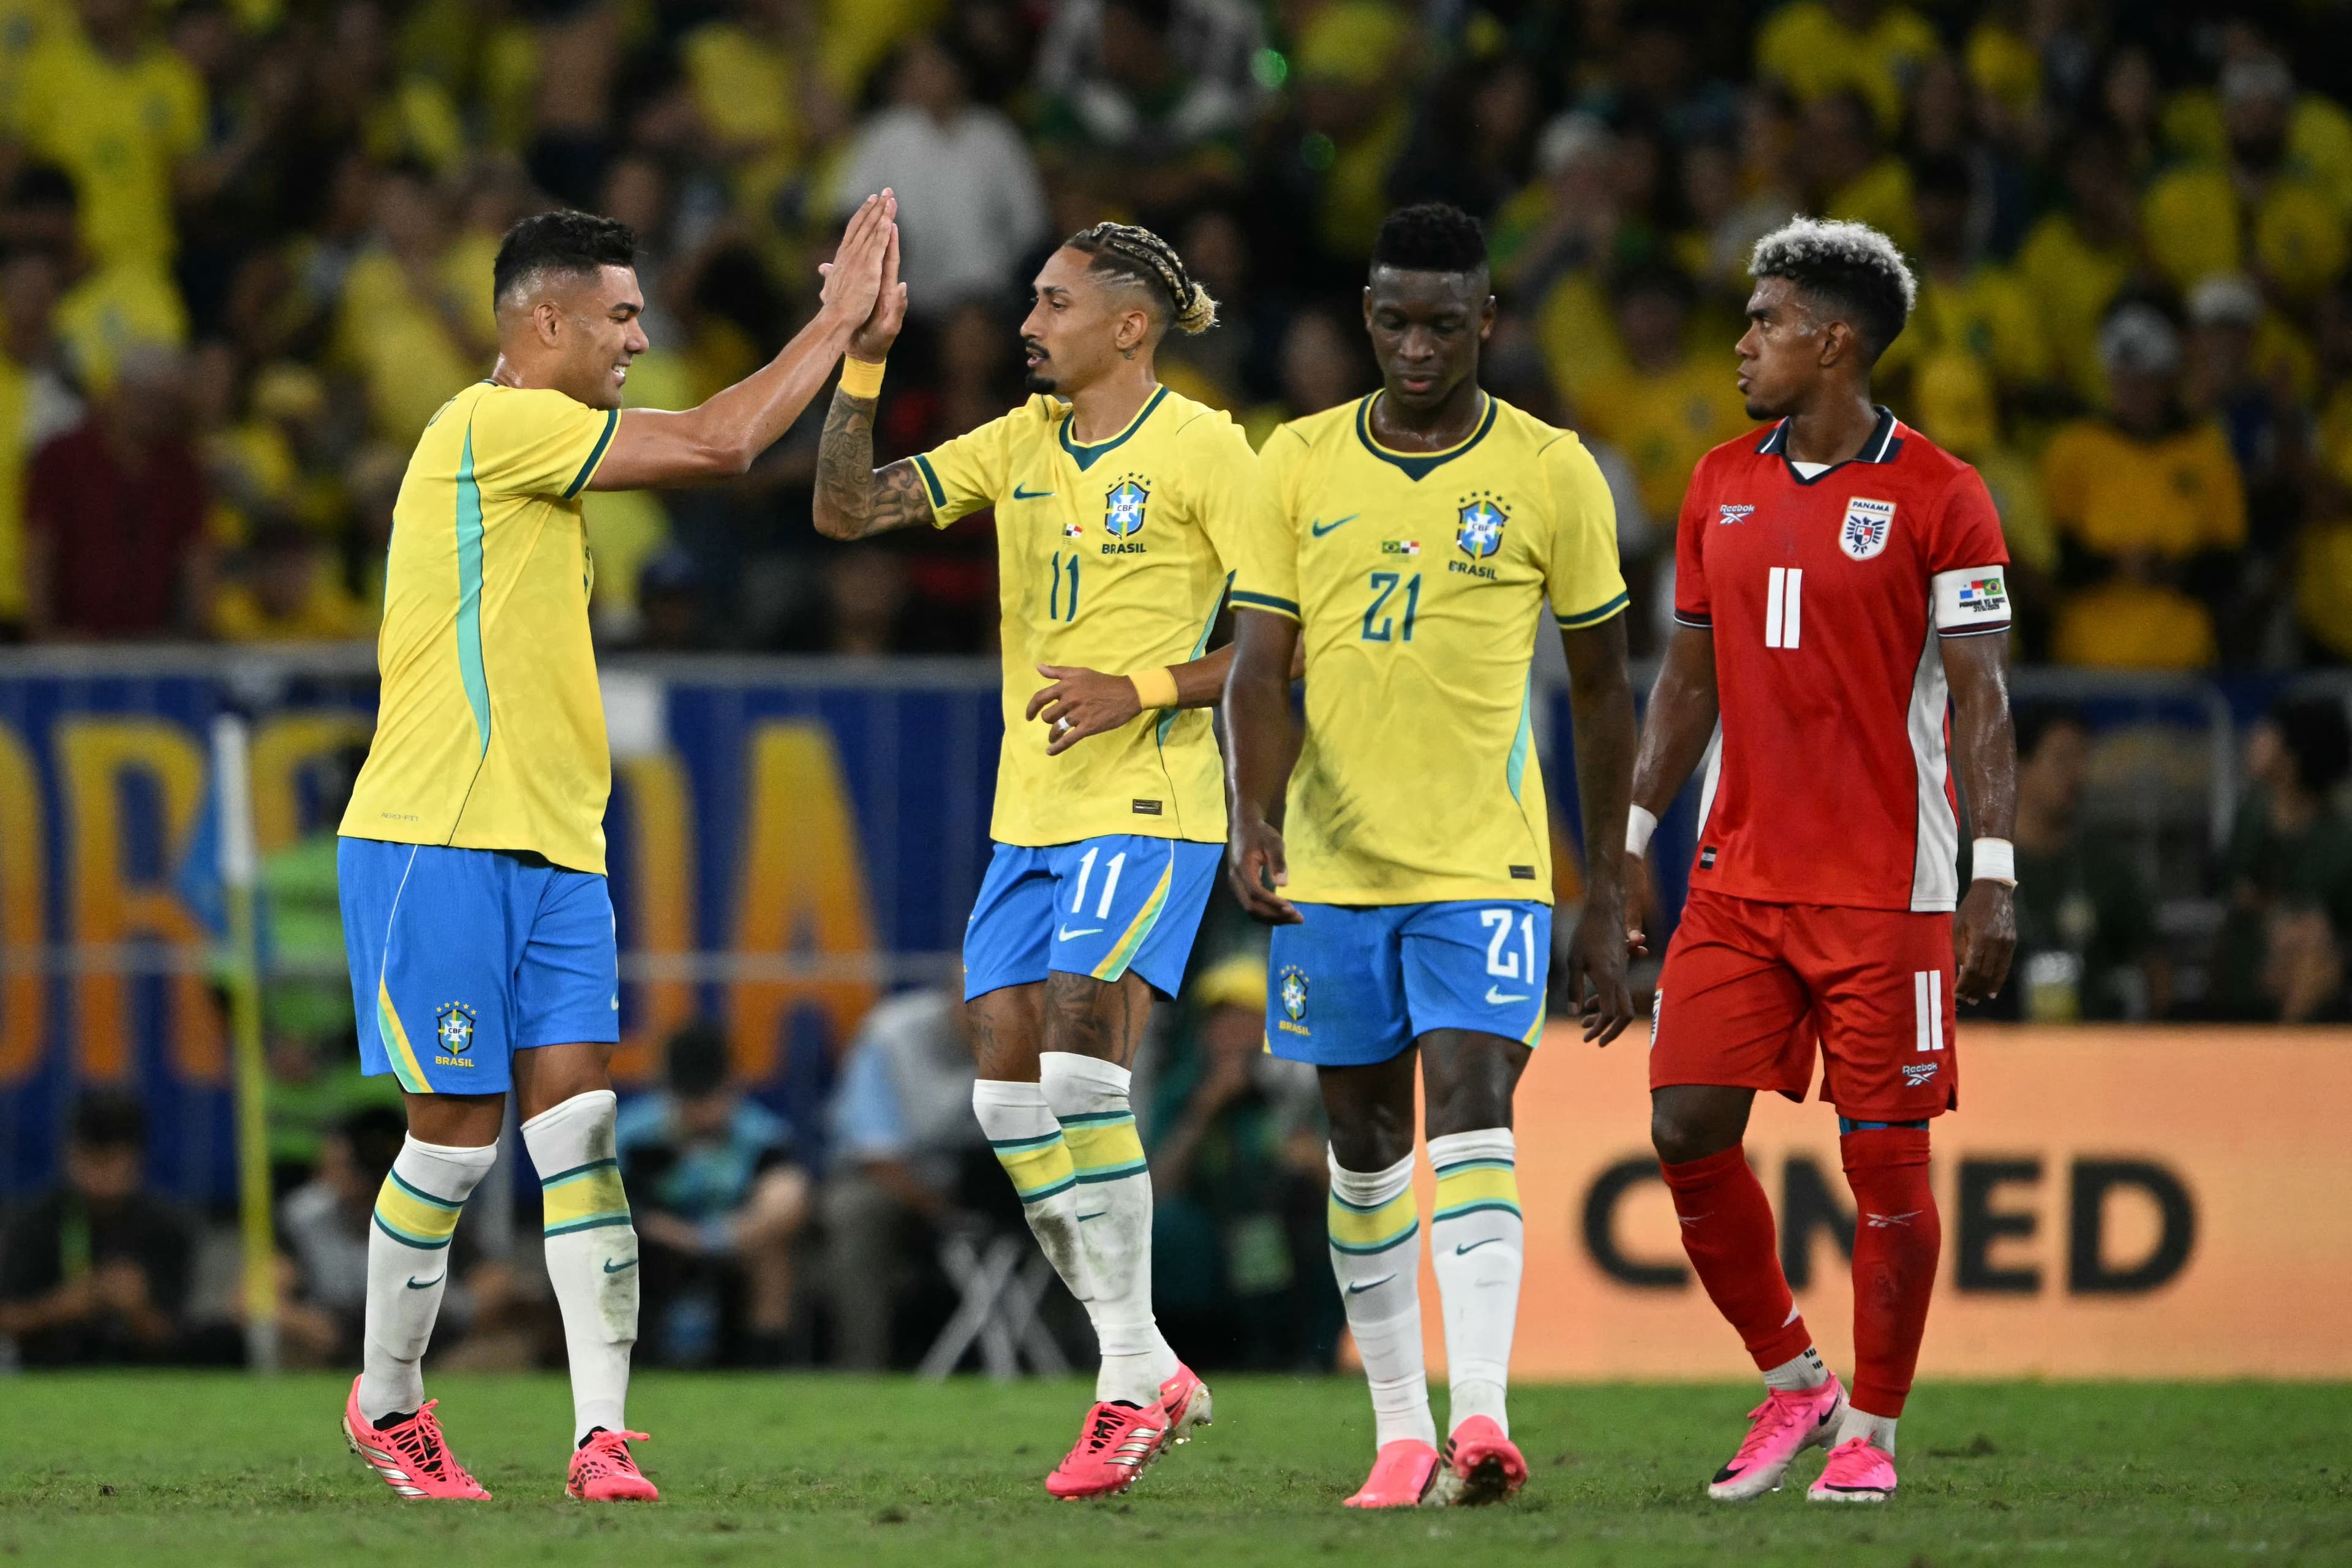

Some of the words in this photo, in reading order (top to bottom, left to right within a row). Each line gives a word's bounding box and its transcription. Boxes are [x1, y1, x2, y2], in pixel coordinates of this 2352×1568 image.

[1719, 504, 1755, 513] Reebok
[1102, 543, 1147, 554] BRASIL
[1449, 560, 1498, 580] BRASIL
[1050, 551, 1079, 622] 11
[1362, 573, 1421, 642] 21
[1766, 567, 1803, 649] 11
[1071, 846, 1126, 919] 11
[1480, 909, 1534, 984] 21
[1279, 1020, 1311, 1036] BRASIL
[1915, 970, 1944, 1052] 11
[435, 1055, 475, 1067] BRASIL
[1902, 1063, 1938, 1074] Reebok
